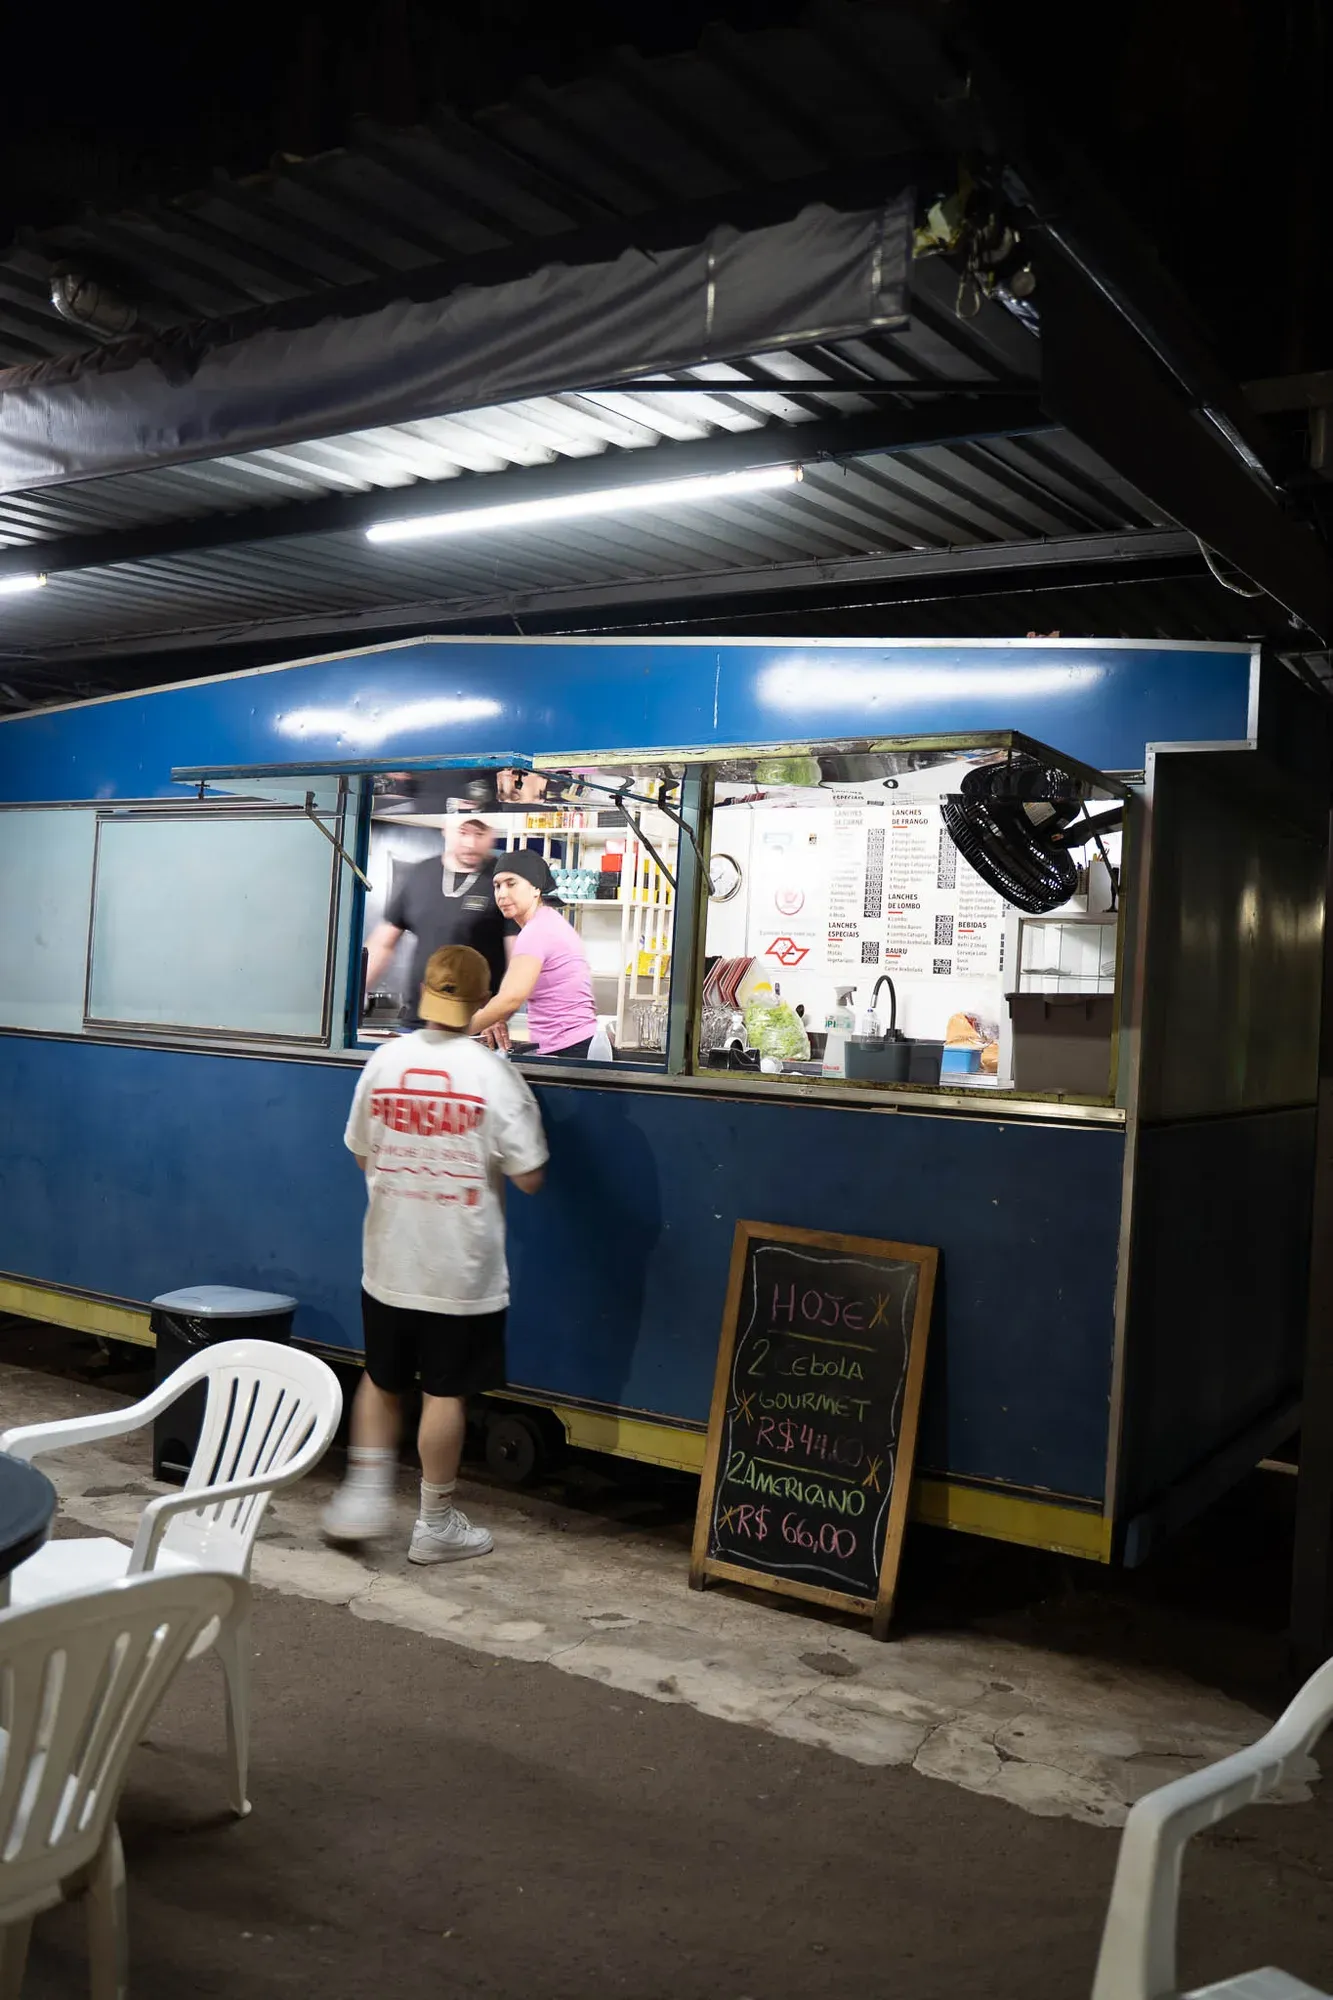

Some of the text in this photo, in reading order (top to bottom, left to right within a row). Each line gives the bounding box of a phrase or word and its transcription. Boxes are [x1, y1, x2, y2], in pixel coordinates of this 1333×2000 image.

[772, 1283, 865, 1330] HOJE
[747, 1338, 770, 1376] 2
[759, 1390, 872, 1422] GOURMET
[737, 1504, 857, 1558] R$ 66,00
